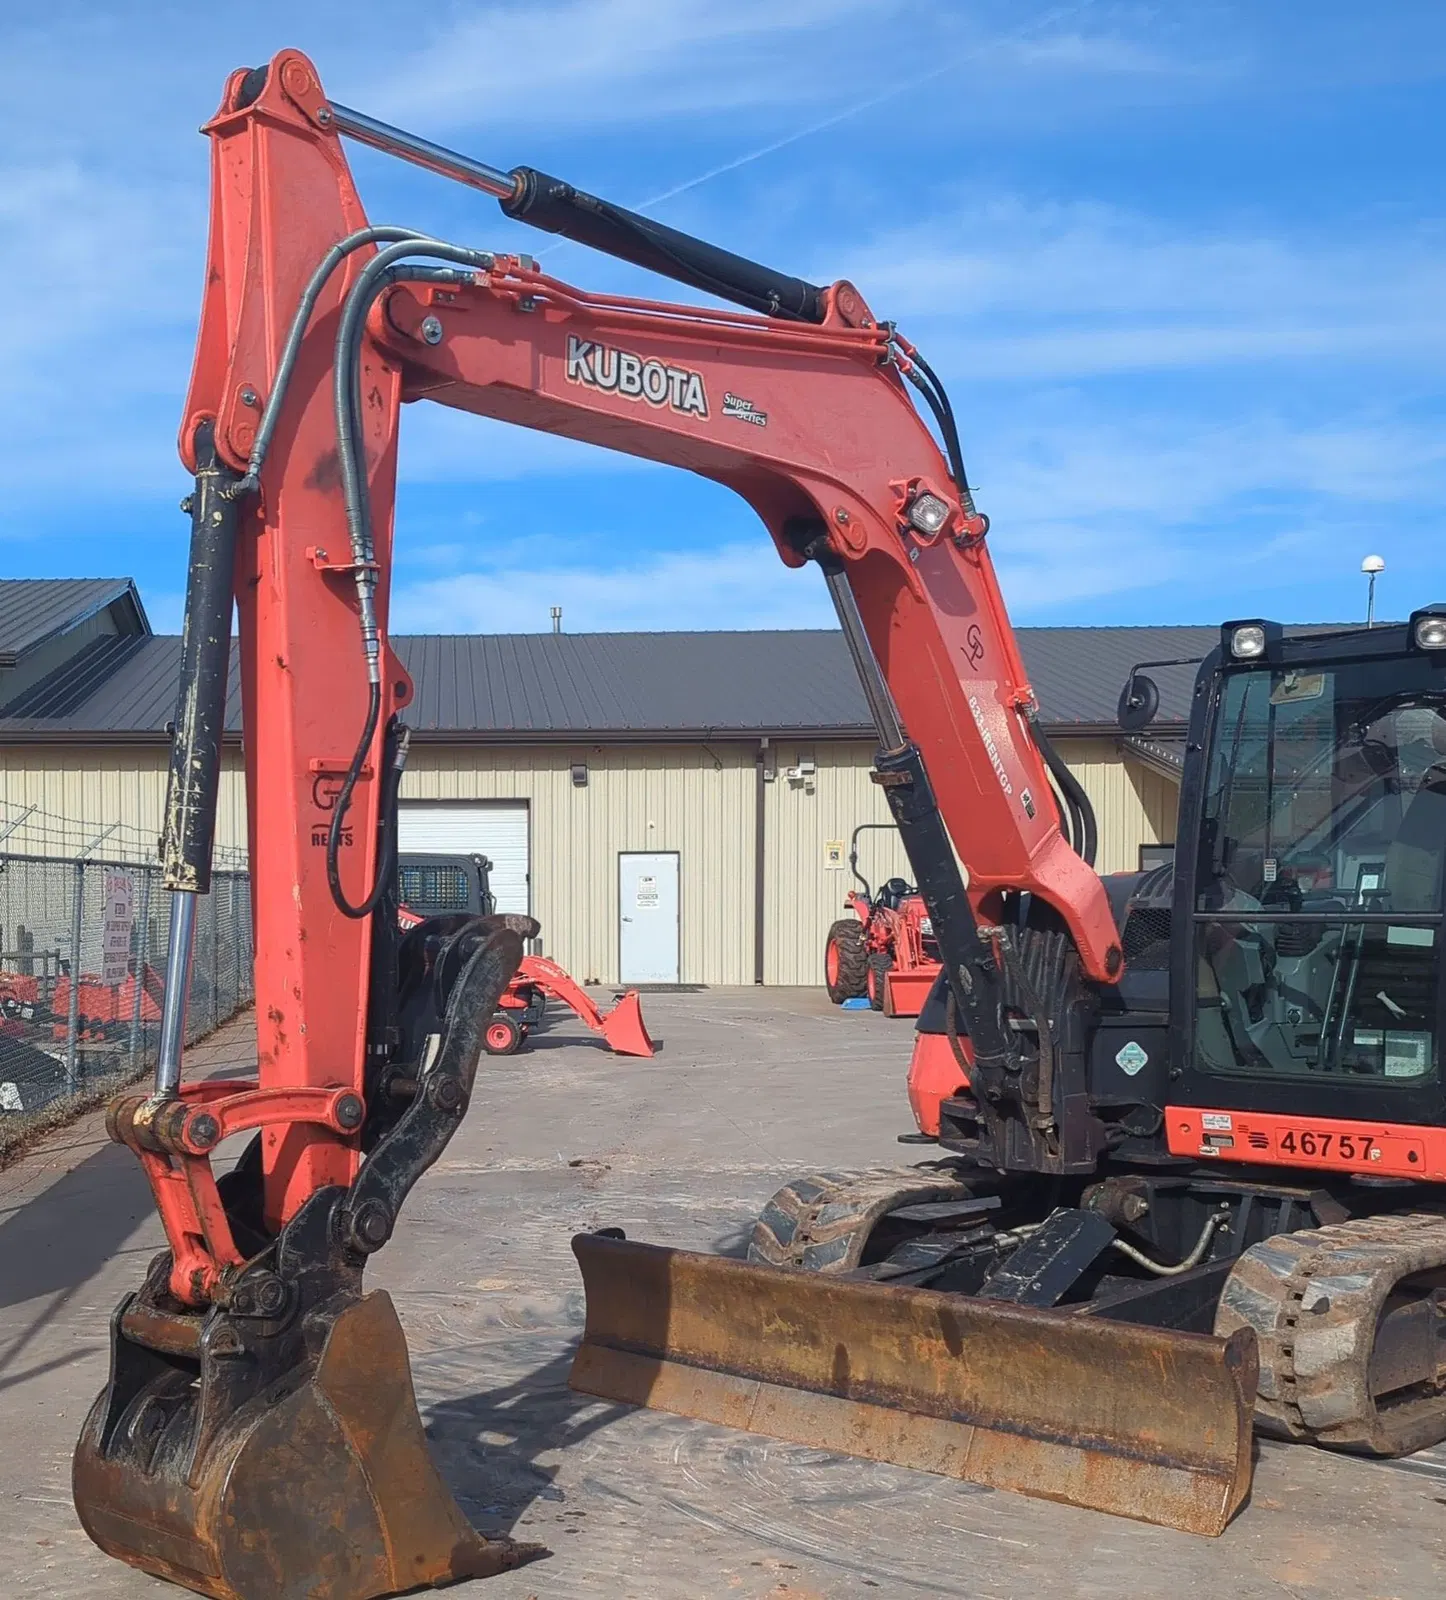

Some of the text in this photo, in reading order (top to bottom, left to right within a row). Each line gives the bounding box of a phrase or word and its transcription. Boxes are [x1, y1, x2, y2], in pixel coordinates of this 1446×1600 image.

[567, 334, 708, 417] KUBOTA
[723, 392, 753, 411] Super
[736, 408, 767, 426] Series
[1280, 1131, 1375, 1160] 46757
